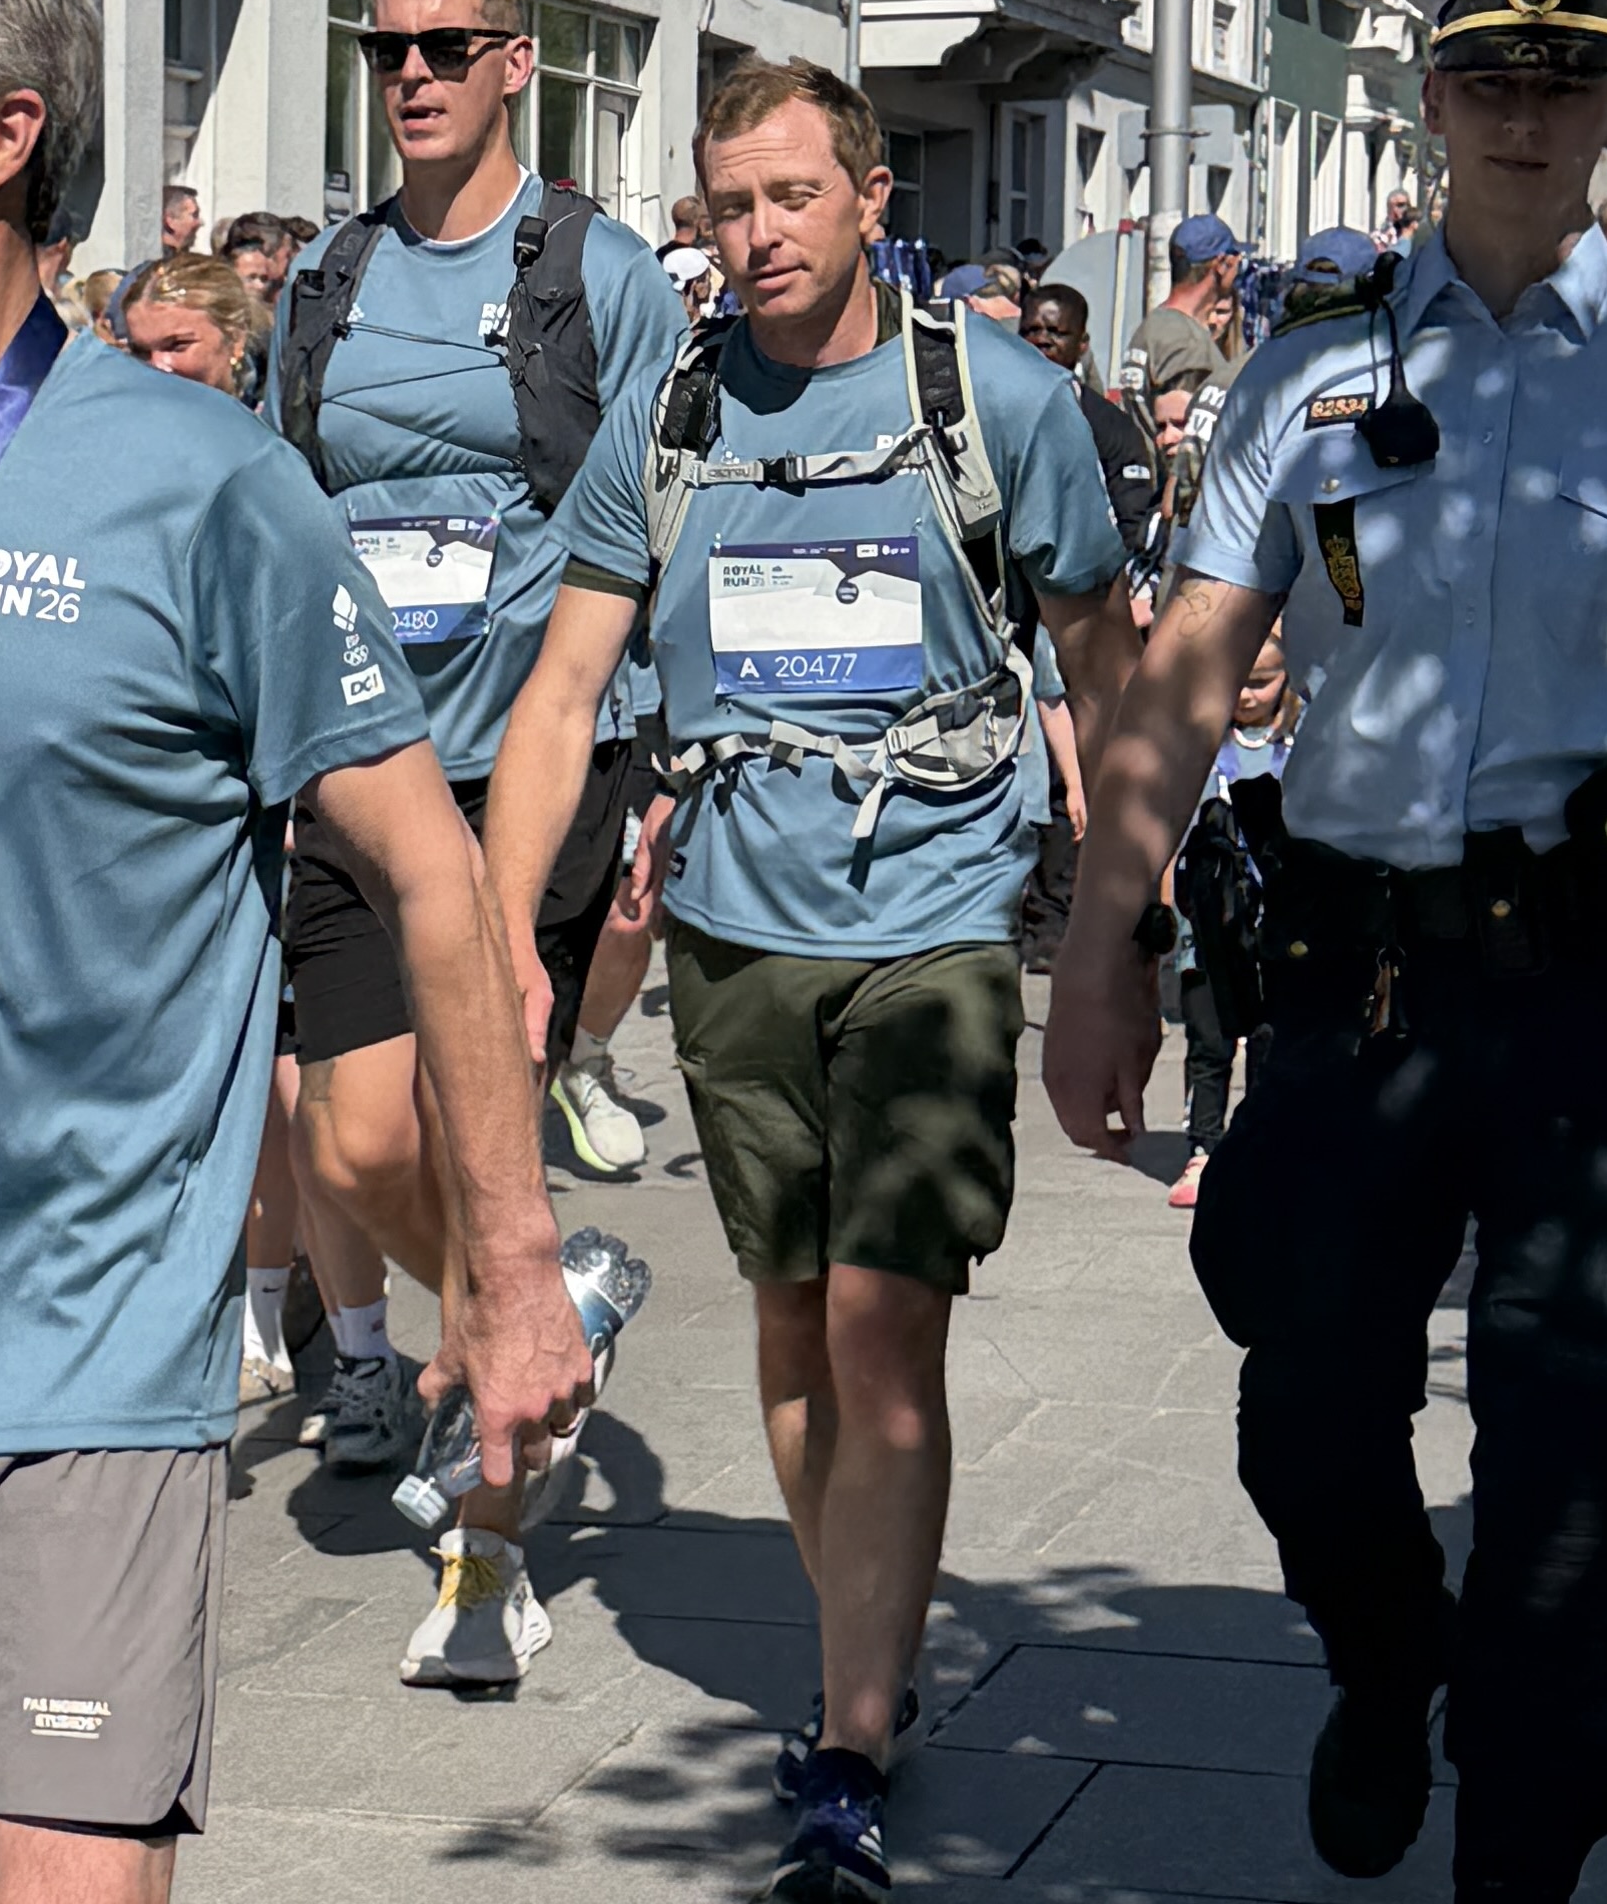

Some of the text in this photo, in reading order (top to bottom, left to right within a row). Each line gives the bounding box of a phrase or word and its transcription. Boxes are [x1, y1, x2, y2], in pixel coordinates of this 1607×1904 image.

[723, 565, 765, 576] ROYAL
[739, 652, 858, 679] A 20477
[49, 1699, 112, 1716] NORMAL
